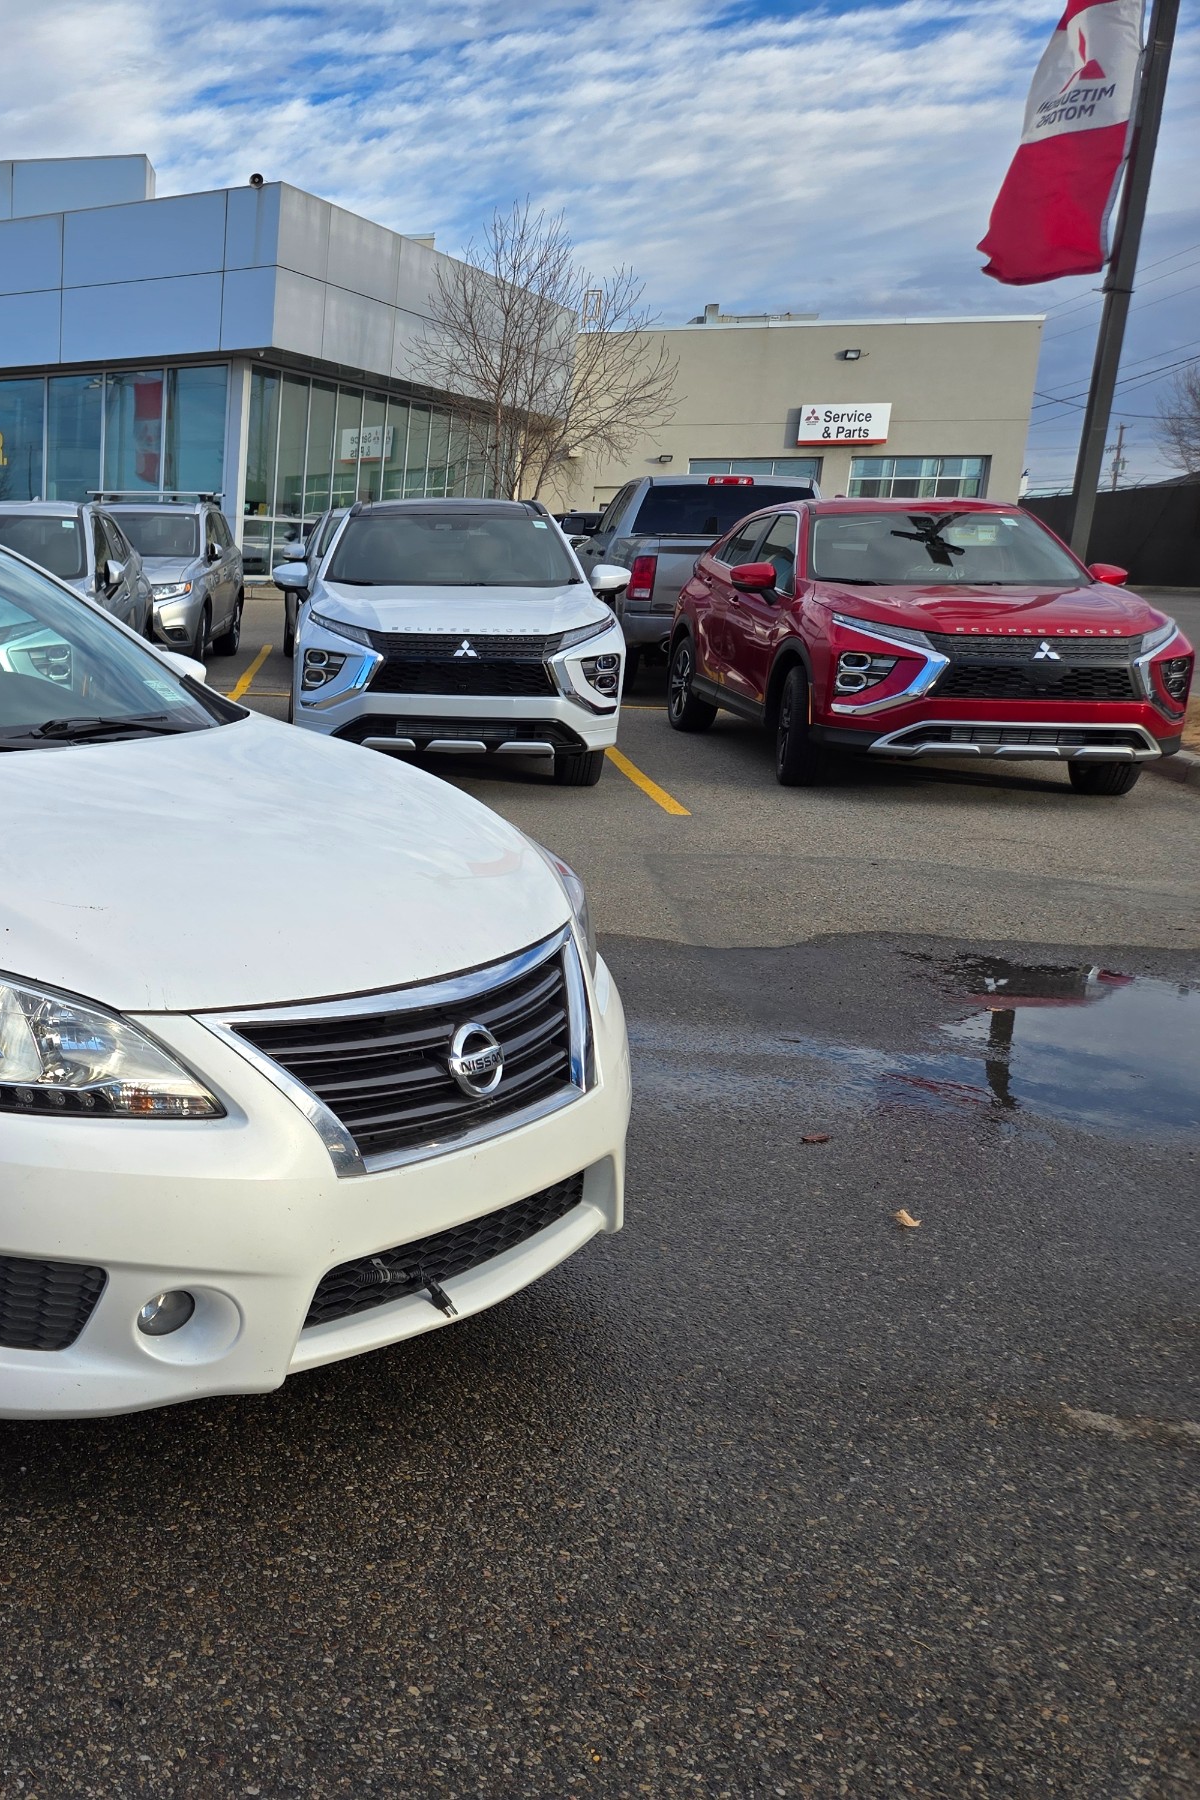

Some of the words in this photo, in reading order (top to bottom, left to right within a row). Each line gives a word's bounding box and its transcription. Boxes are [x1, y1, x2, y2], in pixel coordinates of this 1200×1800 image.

[823, 410, 872, 422] Service
[822, 426, 831, 438] &
[836, 426, 869, 438] Parts
[460, 1051, 504, 1073] NISSAN
